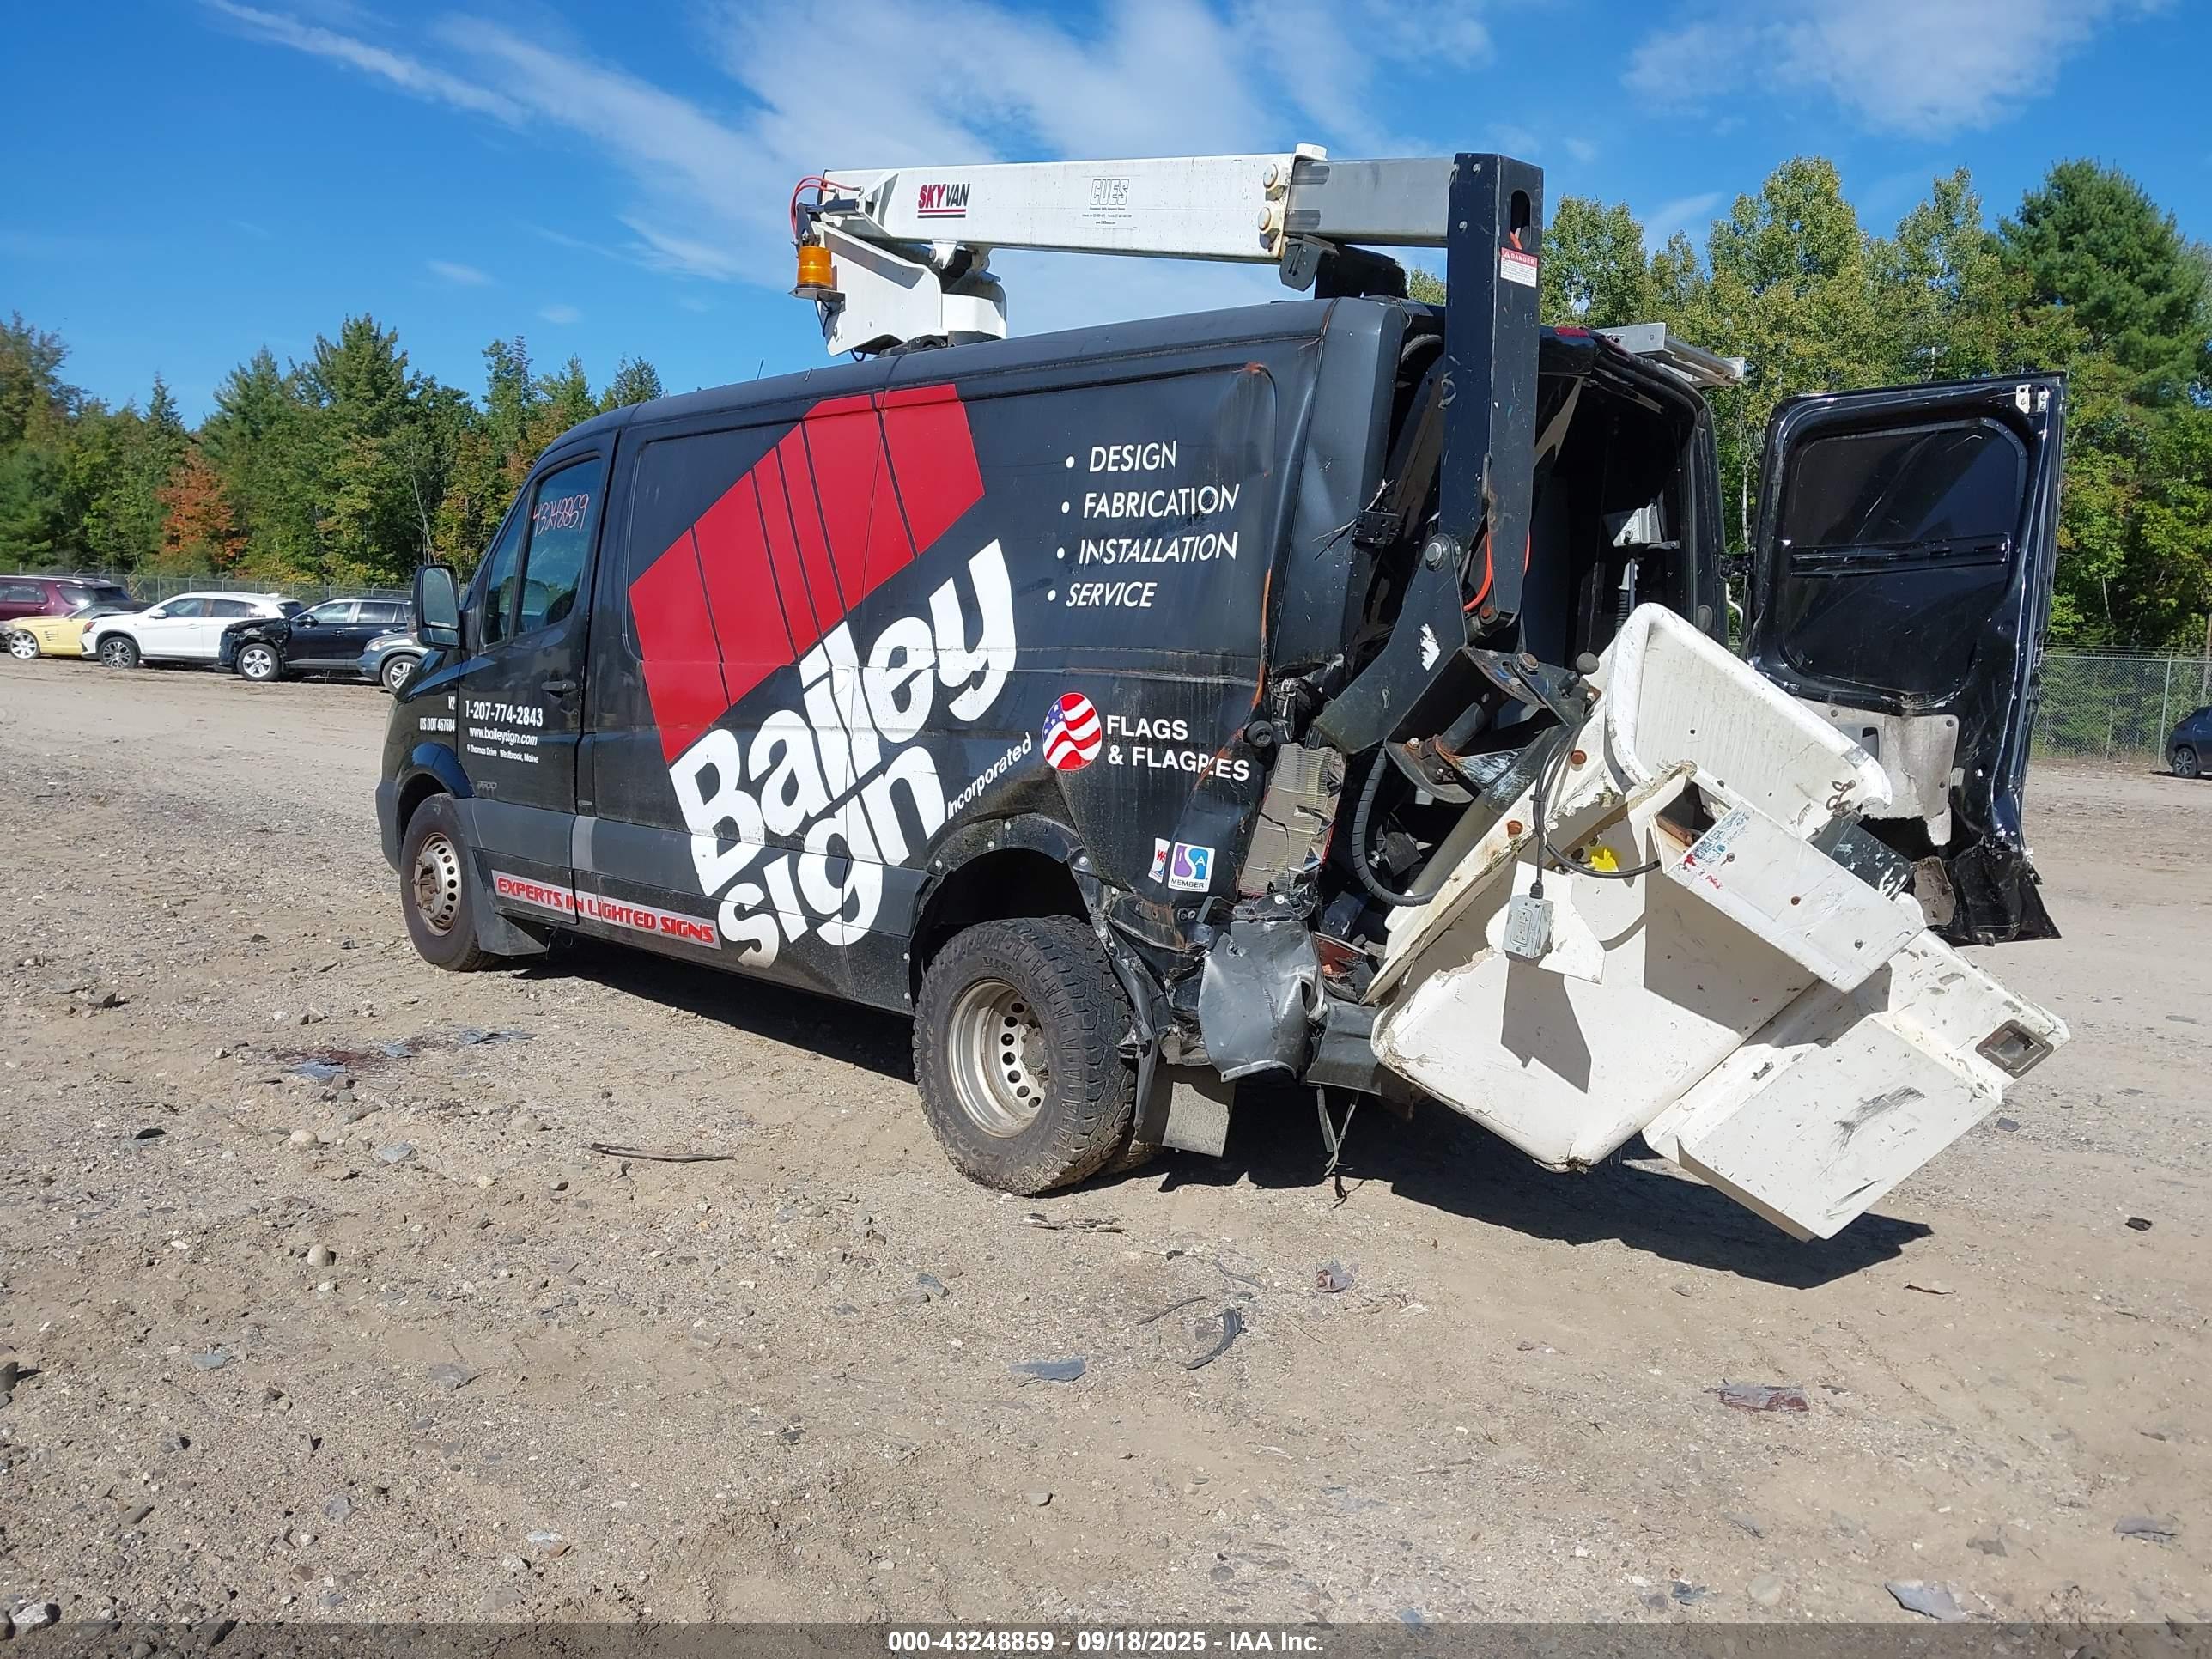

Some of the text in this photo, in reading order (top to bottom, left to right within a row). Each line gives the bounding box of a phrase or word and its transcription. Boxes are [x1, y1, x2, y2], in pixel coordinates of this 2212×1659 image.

[918, 183, 971, 209] SKYVAN
[1090, 178, 1130, 205] CUES
[1510, 252, 1535, 266] DANGER
[1089, 440, 1176, 472] DESIGN
[1083, 483, 1240, 519] FABRICATION
[1079, 532, 1238, 565] INSTALLATION
[1066, 581, 1158, 608] SERVICE
[465, 700, 544, 727] 1-207-774-2843
[669, 538, 1017, 897] Bailey
[468, 726, 538, 746] www.baileysign.com
[1106, 714, 1188, 741] FLAGS
[1107, 744, 1124, 766] &
[947, 731, 1032, 820] Incorporated
[718, 746, 945, 969] sign
[1170, 878, 1205, 889] MEMBER
[497, 877, 714, 944] EXPERTS IN LIGHTED SIGNS
